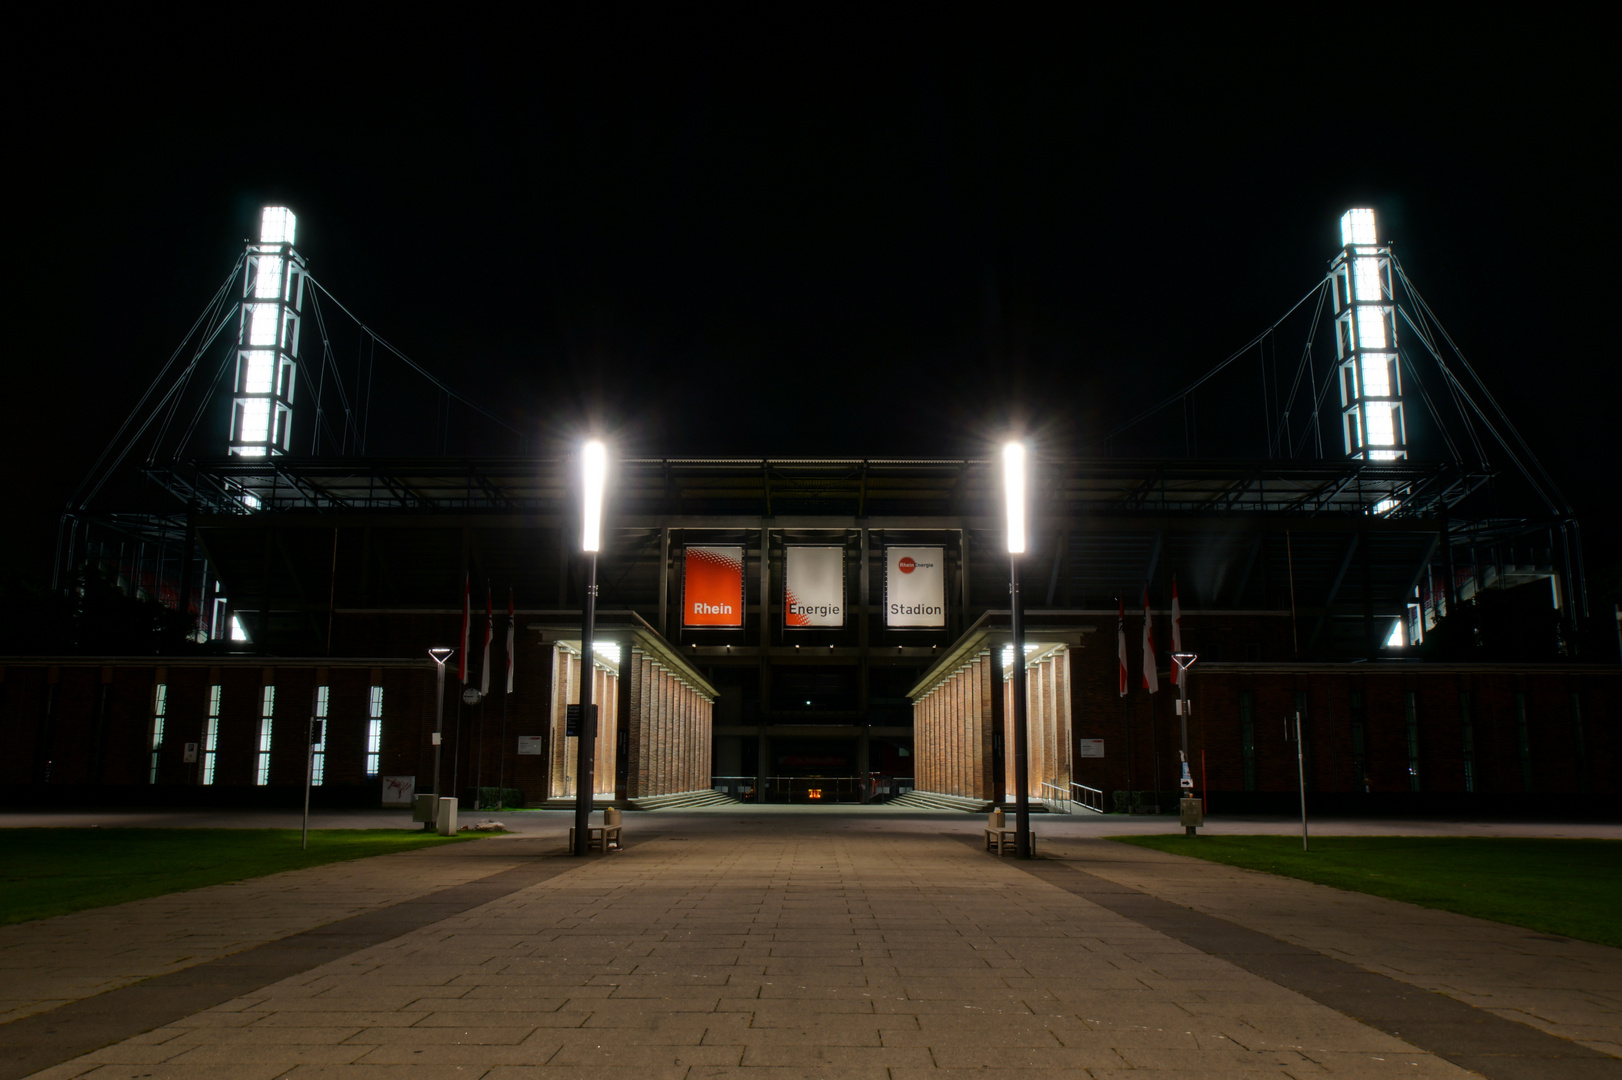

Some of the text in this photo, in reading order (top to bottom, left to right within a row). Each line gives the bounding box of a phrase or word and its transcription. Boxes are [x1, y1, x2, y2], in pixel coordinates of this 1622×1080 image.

[693, 603, 732, 615] Rhein
[789, 603, 841, 617] Energie
[890, 603, 942, 616] Stadion
